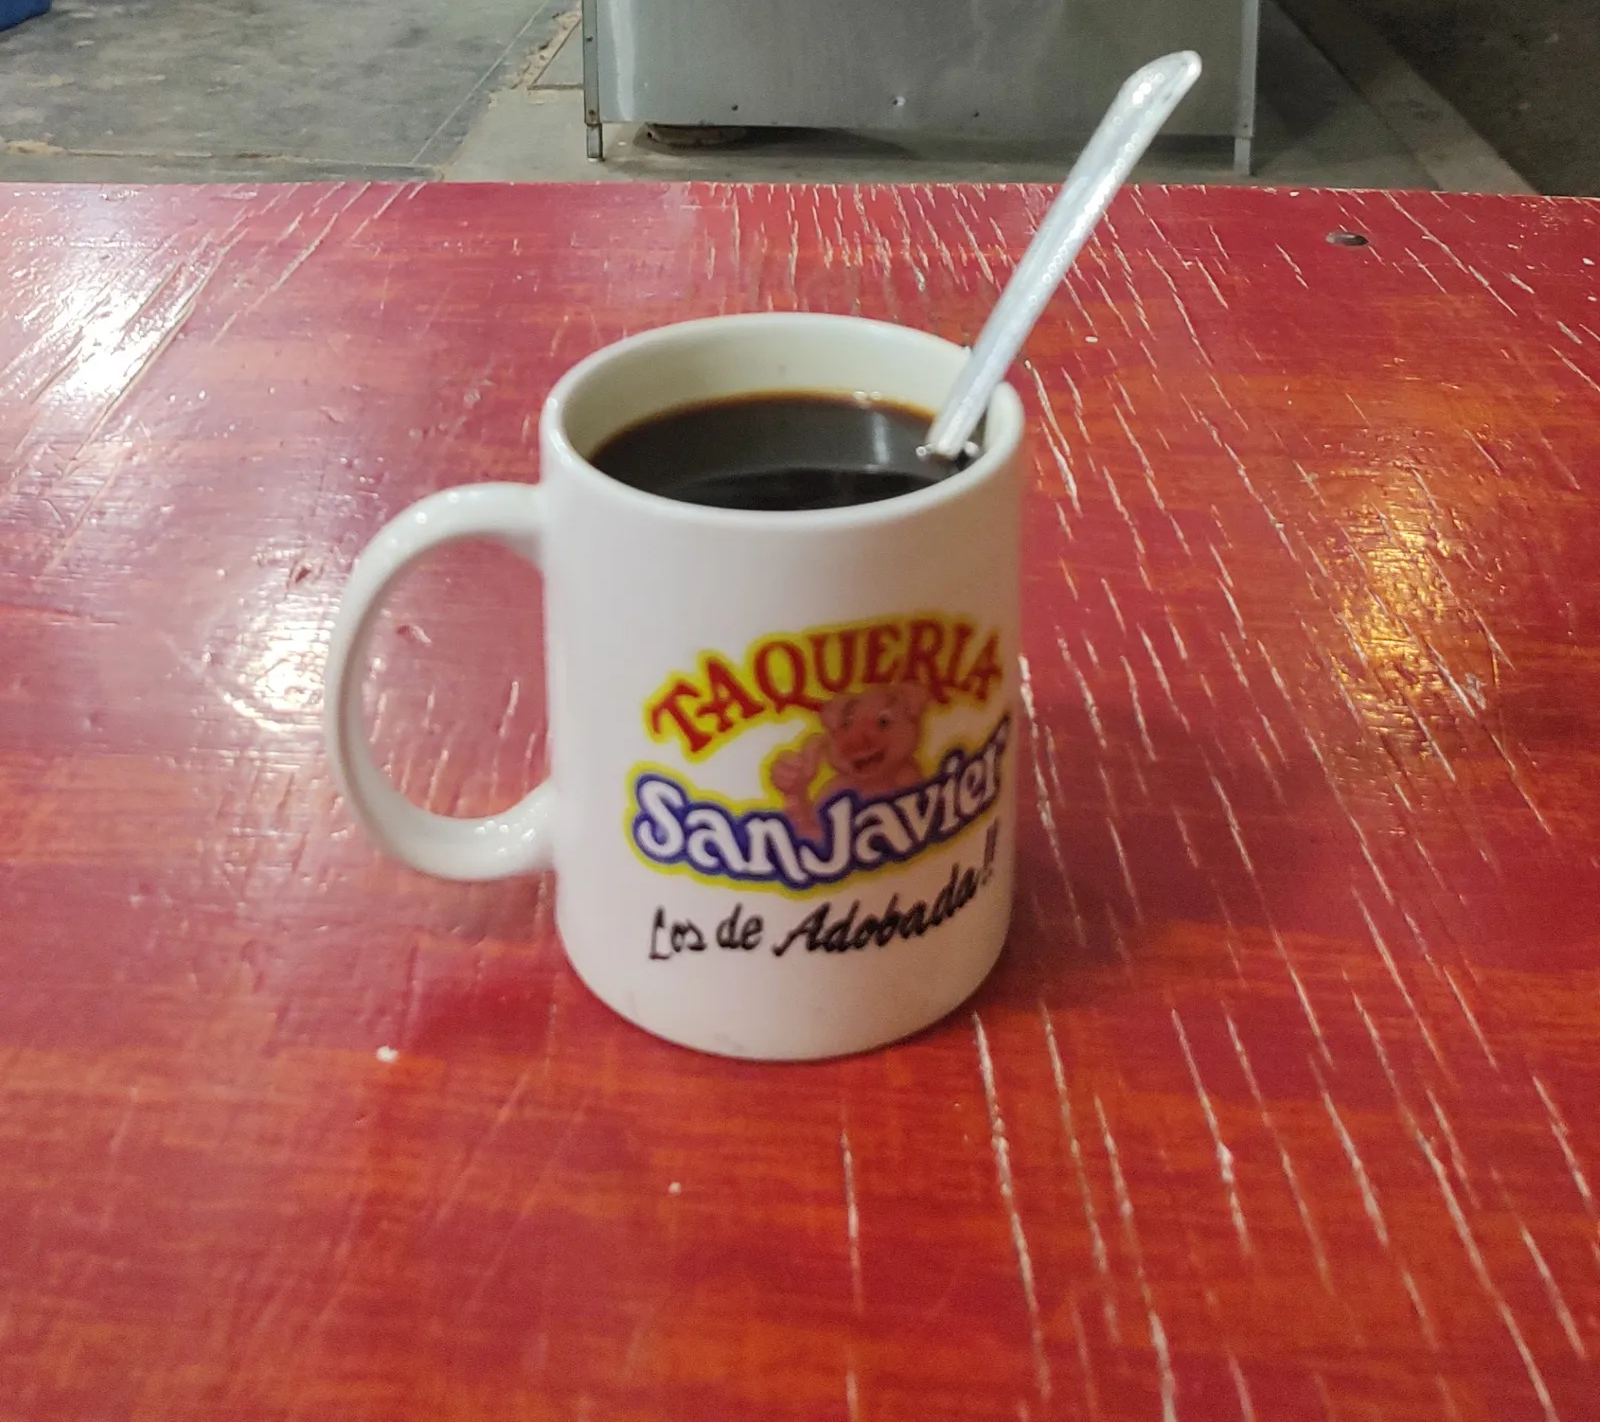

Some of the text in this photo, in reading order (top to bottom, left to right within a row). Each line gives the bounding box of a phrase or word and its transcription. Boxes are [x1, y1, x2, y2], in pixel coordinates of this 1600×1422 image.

[650, 617, 1003, 754] TAQUERIA
[634, 712, 1012, 887] San Javier
[649, 903, 706, 961] Los
[715, 901, 764, 952] de
